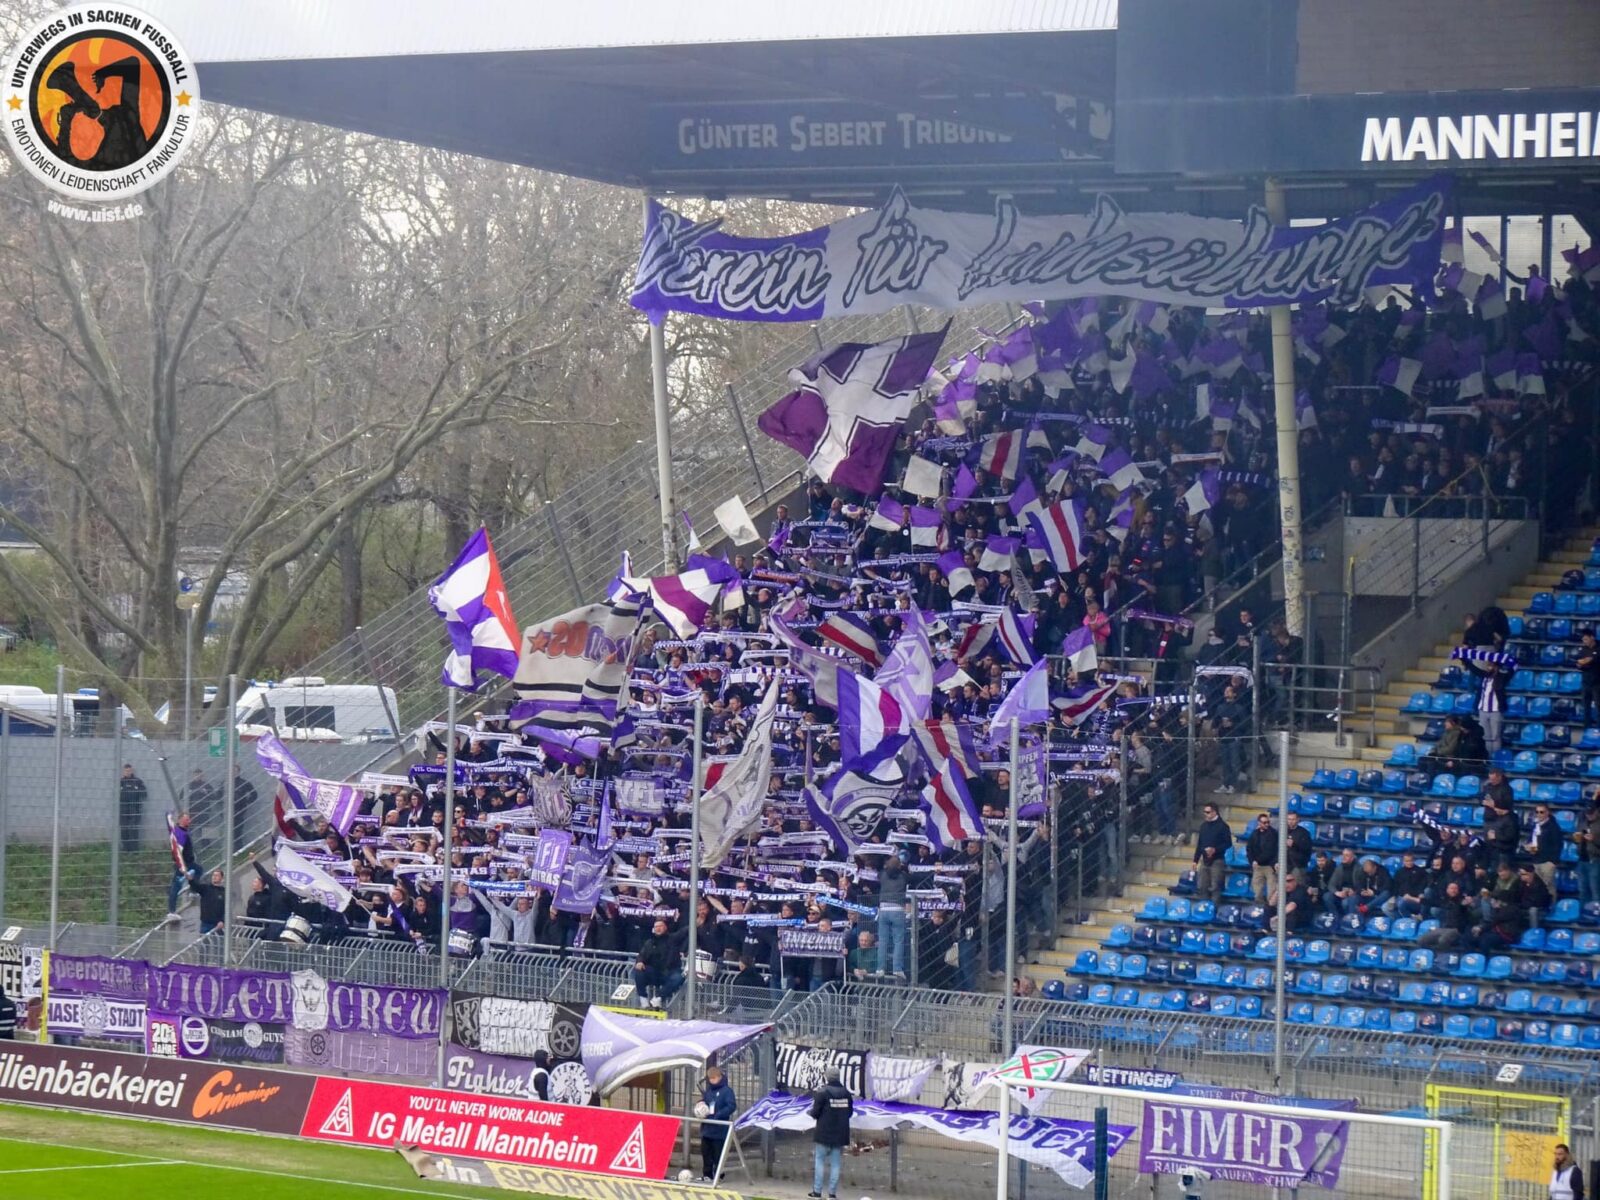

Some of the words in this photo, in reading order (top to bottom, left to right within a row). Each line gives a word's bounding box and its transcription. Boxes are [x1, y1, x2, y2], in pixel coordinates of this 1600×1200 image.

[790, 115, 887, 151] SEBERT
[50, 958, 132, 984] peerspitze
[109, 1006, 144, 1028] STADT
[1088, 1066, 1176, 1089] METTINGEN
[448, 1101, 487, 1118] NEVER
[488, 1105, 524, 1122] WORK
[525, 1109, 565, 1128] ALONE
[367, 1111, 397, 1140] IG
[400, 1115, 471, 1150] Metall
[474, 1124, 598, 1165] Mannheim
[1150, 1104, 1304, 1171] EIMER
